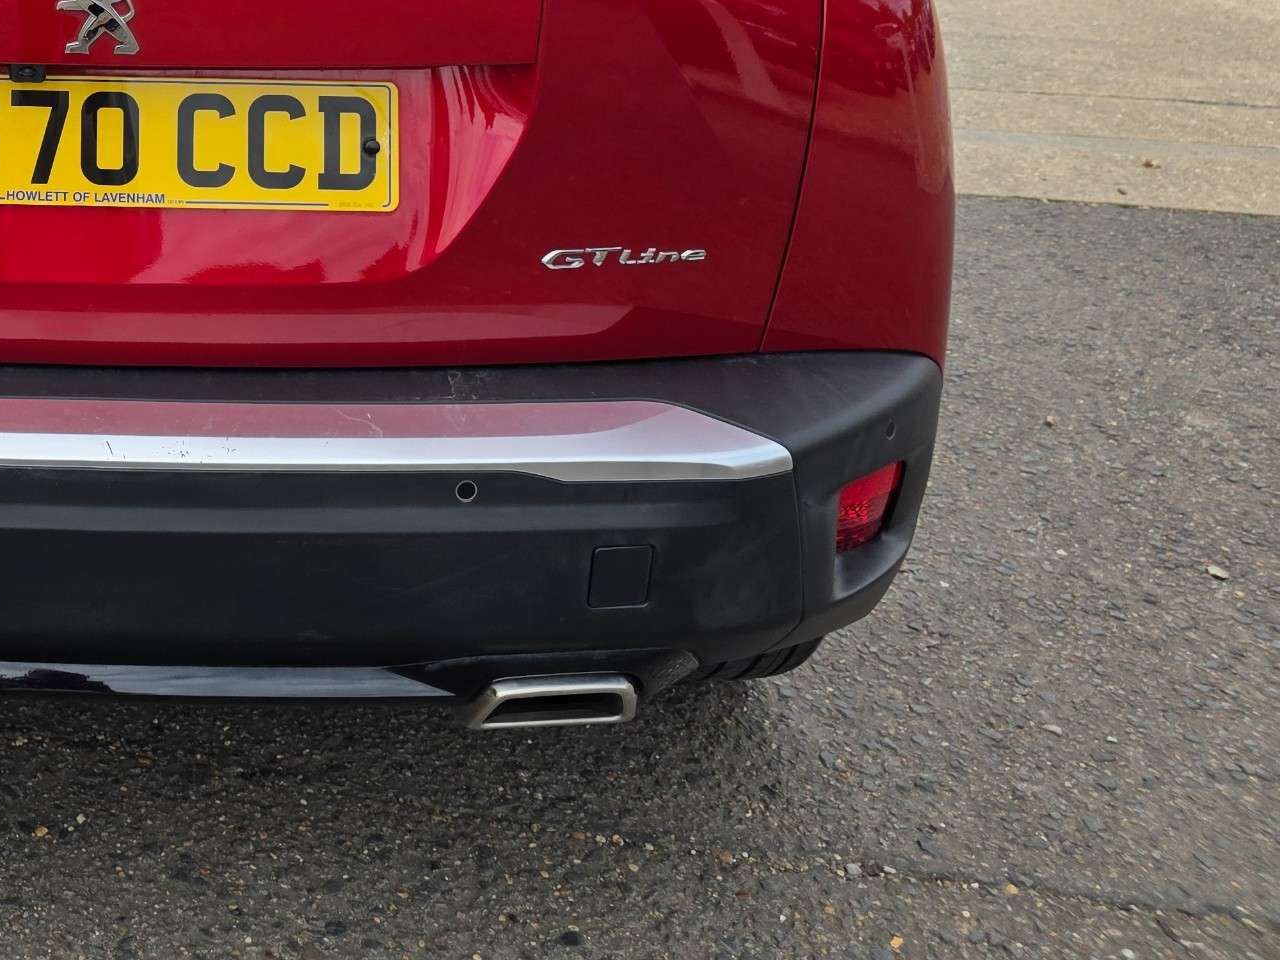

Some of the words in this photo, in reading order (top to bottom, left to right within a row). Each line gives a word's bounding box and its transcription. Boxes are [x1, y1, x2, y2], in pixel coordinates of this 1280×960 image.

[176, 92, 377, 191] CCD
[6, 190, 68, 203] HOWLETT
[72, 191, 90, 203] OF
[94, 192, 166, 205] LAVENHAM
